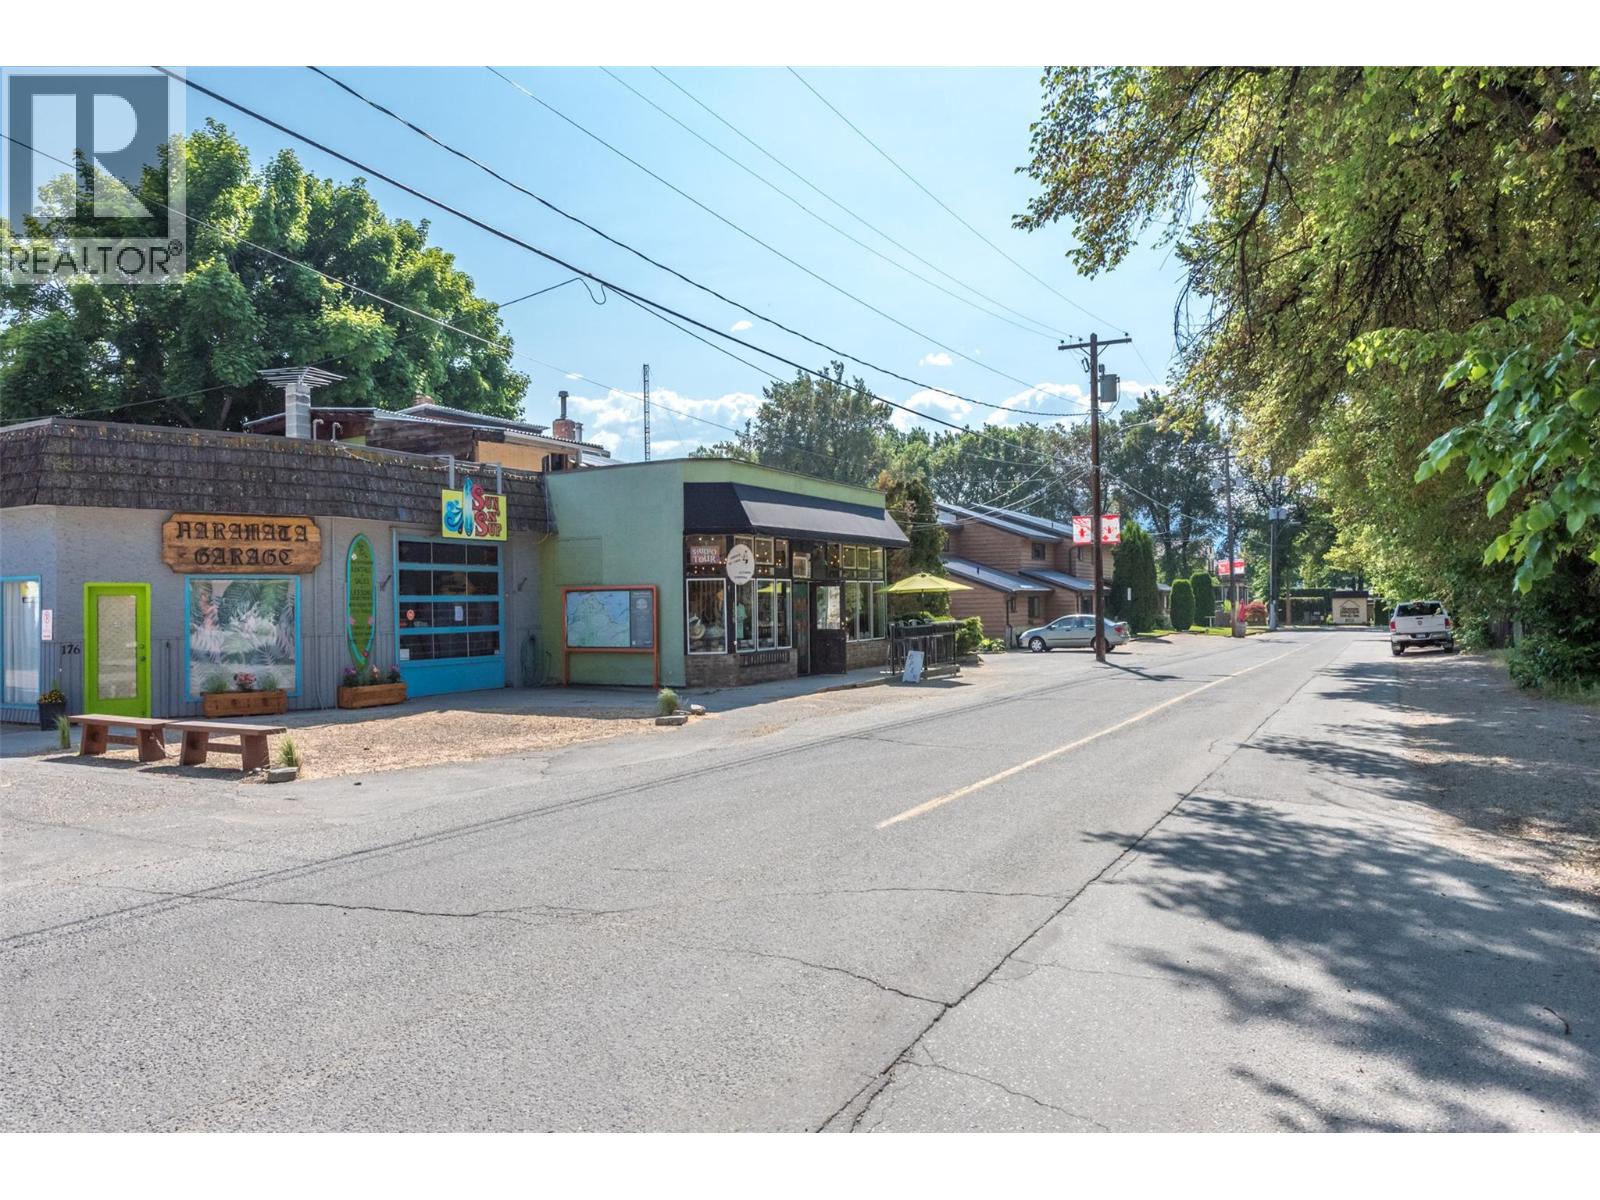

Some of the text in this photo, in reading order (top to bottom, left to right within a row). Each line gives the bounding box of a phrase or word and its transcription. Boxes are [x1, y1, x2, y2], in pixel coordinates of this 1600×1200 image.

[175, 521, 309, 542] NARAMATA
[194, 547, 294, 566] GARAGE
[61, 644, 81, 656] 176
